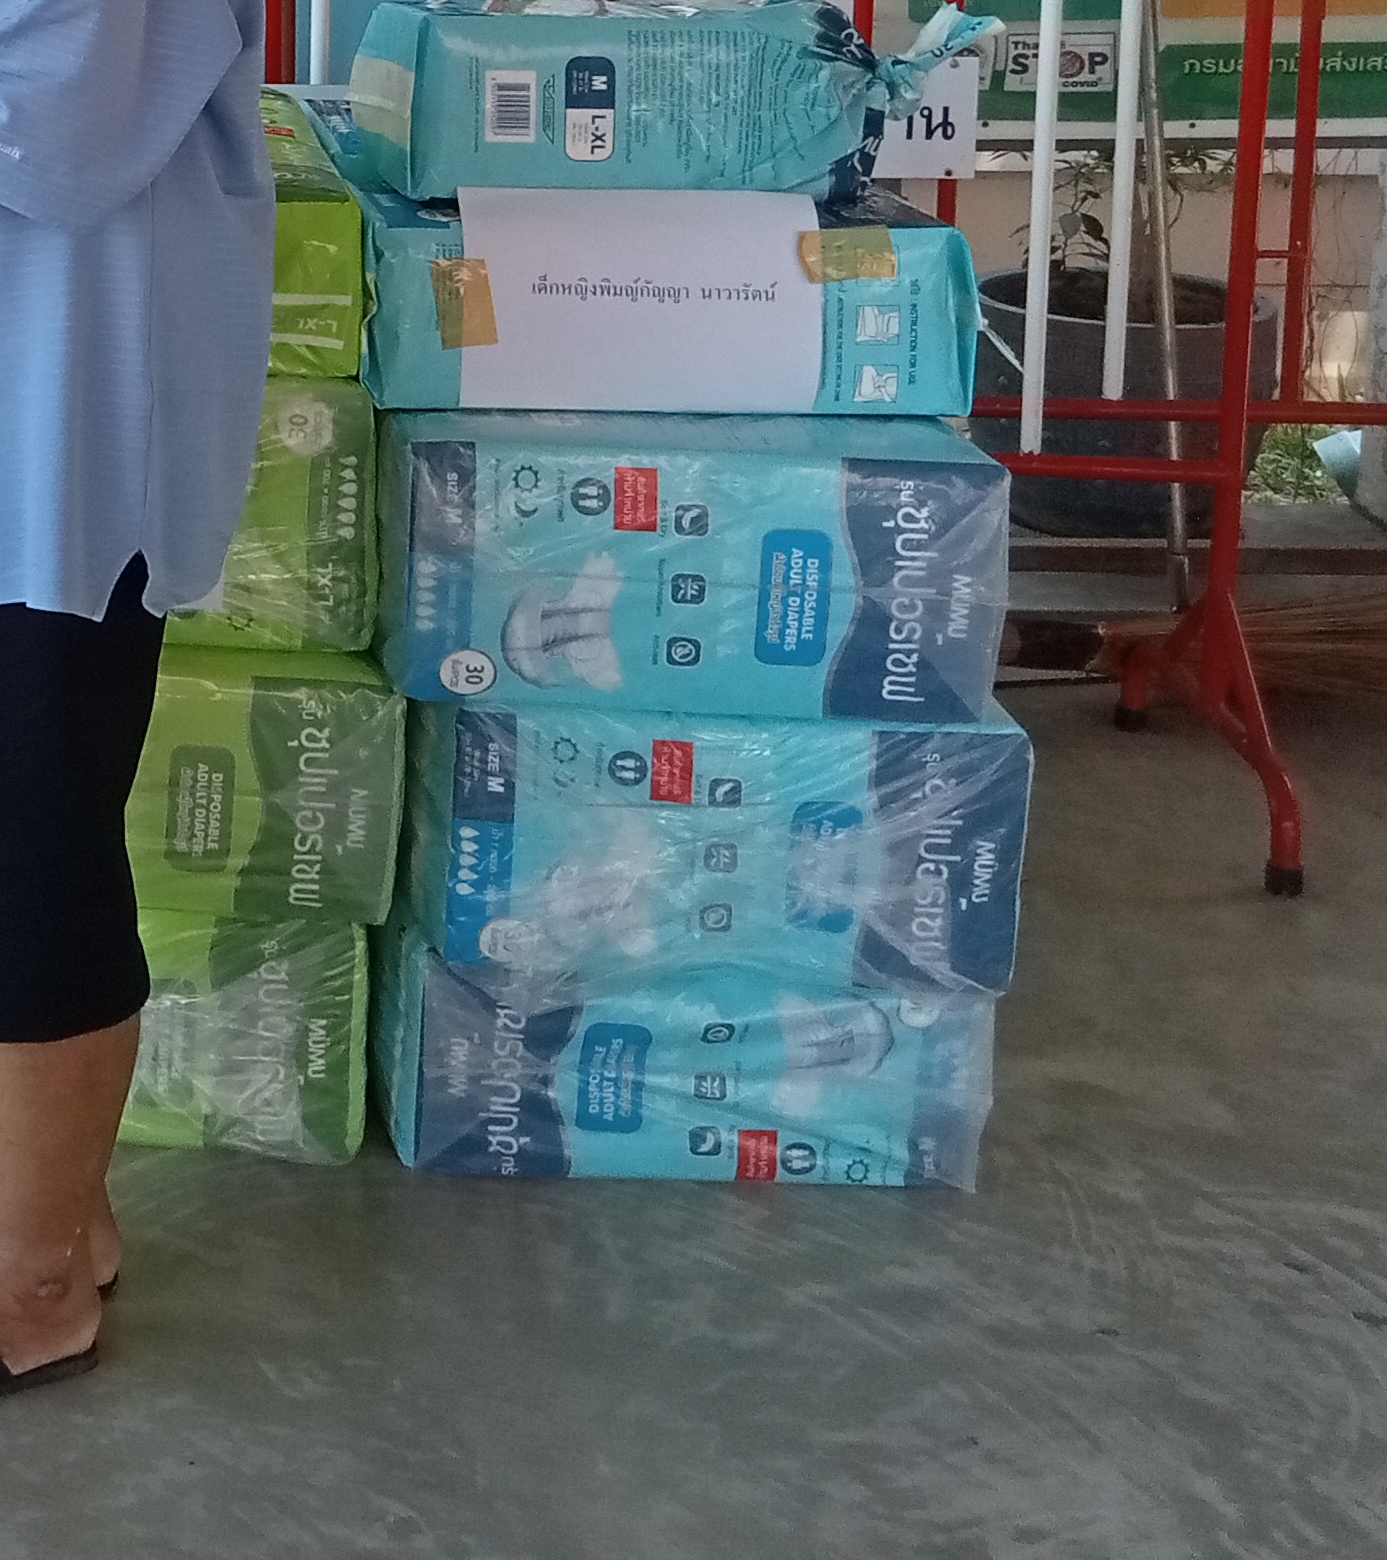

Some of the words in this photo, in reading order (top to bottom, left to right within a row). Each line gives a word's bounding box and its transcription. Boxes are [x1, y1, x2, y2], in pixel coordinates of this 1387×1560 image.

[1011, 41, 1039, 51] Tha
[591, 75, 608, 90] M
[590, 115, 606, 155] L-XL
[701, 281, 778, 302] นาวารัตน์
[316, 562, 333, 607] L-XL
[789, 548, 804, 593] ADULT
[800, 558, 820, 641] DISPOSABLE
[946, 574, 973, 639] MÜMU
[783, 596, 801, 651] DIAPERS
[464, 663, 484, 686] 30
[487, 742, 500, 772] SIZE
[194, 763, 209, 806] ADULT
[487, 776, 504, 793] M
[191, 809, 205, 857] DIAPERS
[206, 773, 223, 850] DISPOSABLE
[971, 841, 998, 903] MÜMU
[307, 1018, 331, 1079] MÜMU
